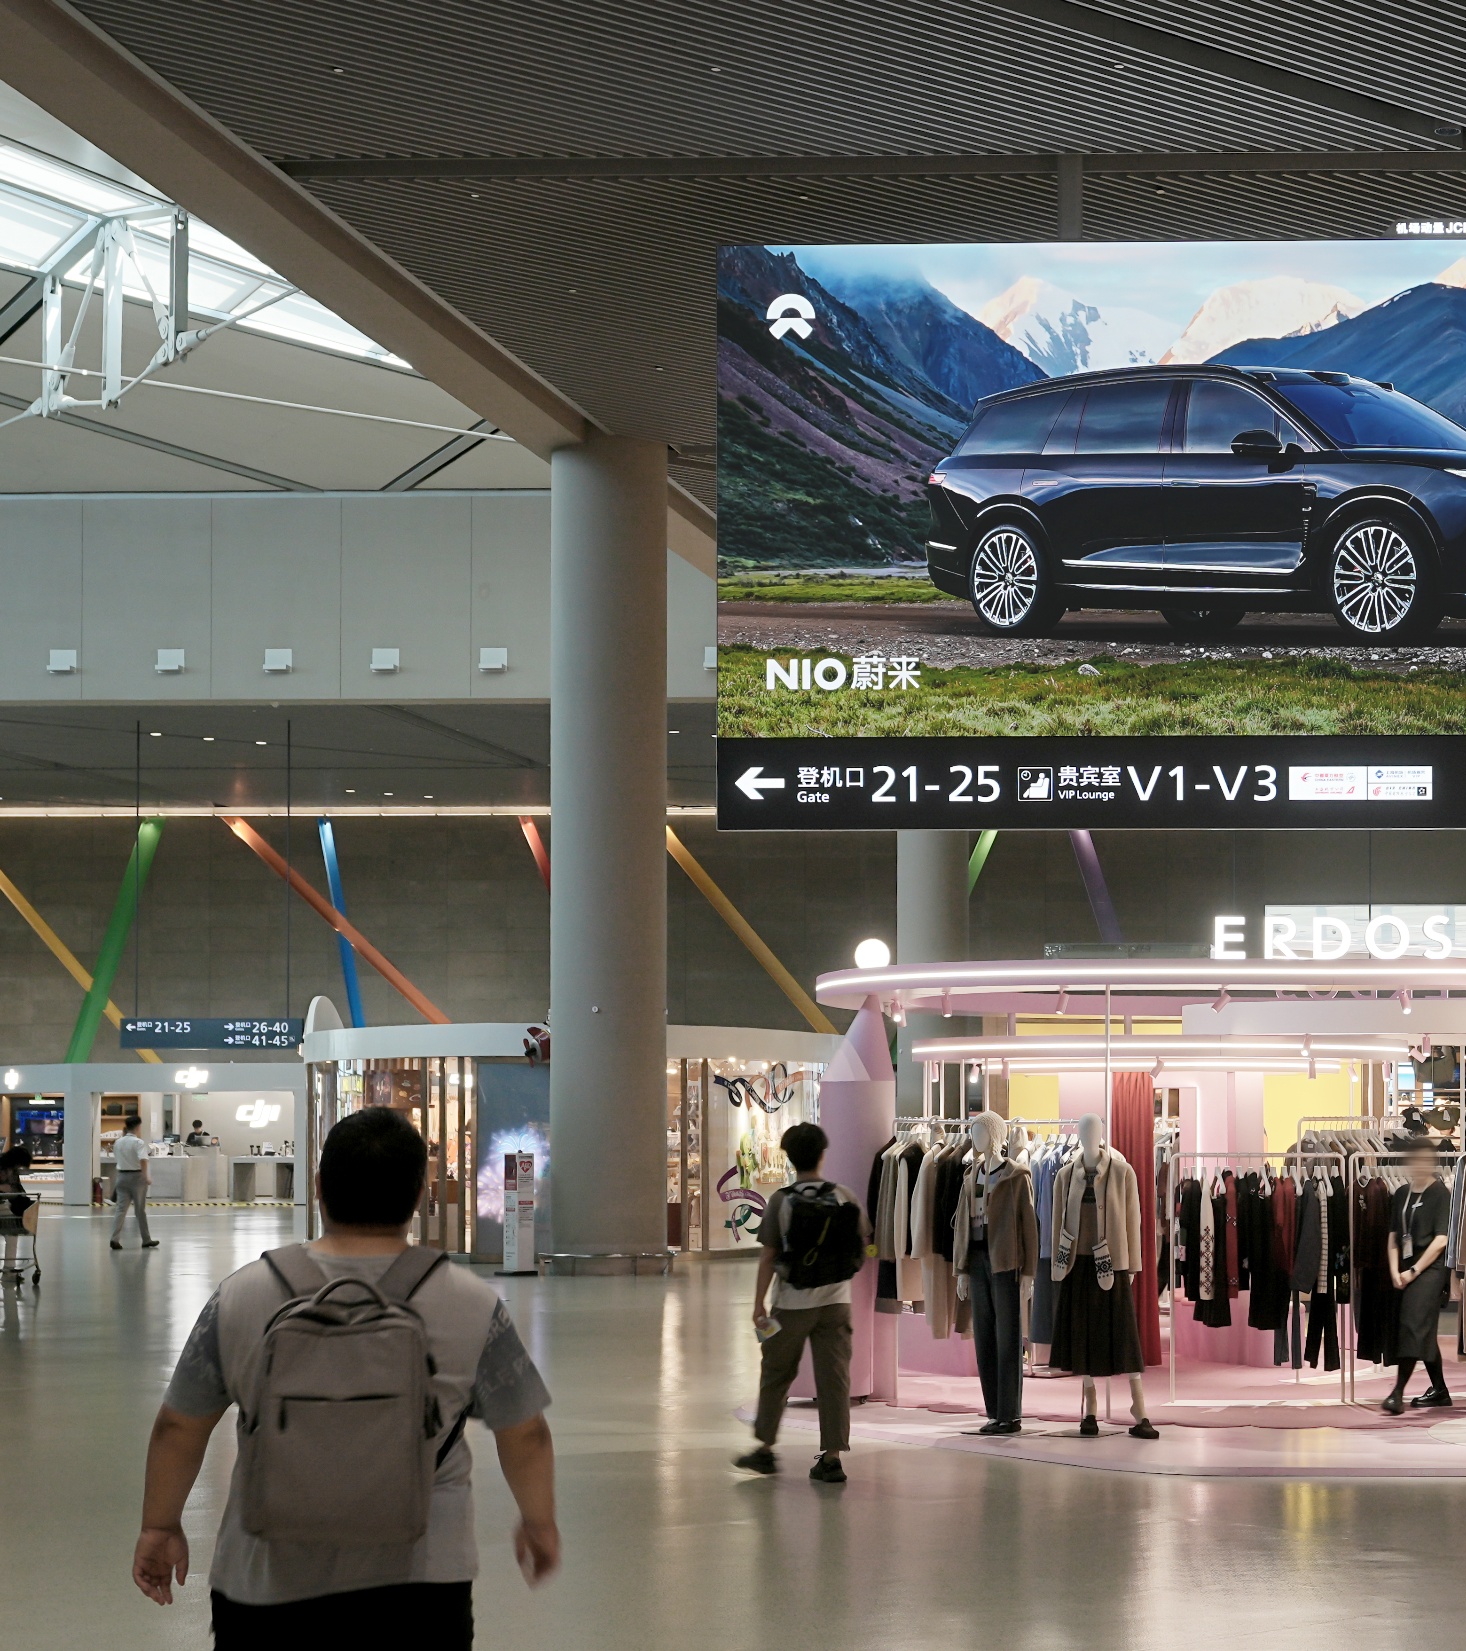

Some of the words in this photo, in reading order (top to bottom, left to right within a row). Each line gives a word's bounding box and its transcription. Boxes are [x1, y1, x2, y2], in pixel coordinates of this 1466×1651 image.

[766, 658, 847, 691] NIO
[851, 655, 922, 691] 蔚来
[796, 766, 864, 788] 登机口
[871, 765, 1000, 802] 21-25
[1057, 765, 1121, 787] 贵宾室
[1127, 765, 1277, 802] V1-V3
[797, 790, 830, 803] Gate
[1058, 790, 1076, 800] VIP
[1079, 790, 1115, 801] Lounge
[1214, 915, 1453, 959] ERDOS
[154, 1021, 191, 1033] 21-25
[252, 1022, 288, 1033] 26-40
[252, 1035, 288, 1046] 41-45
